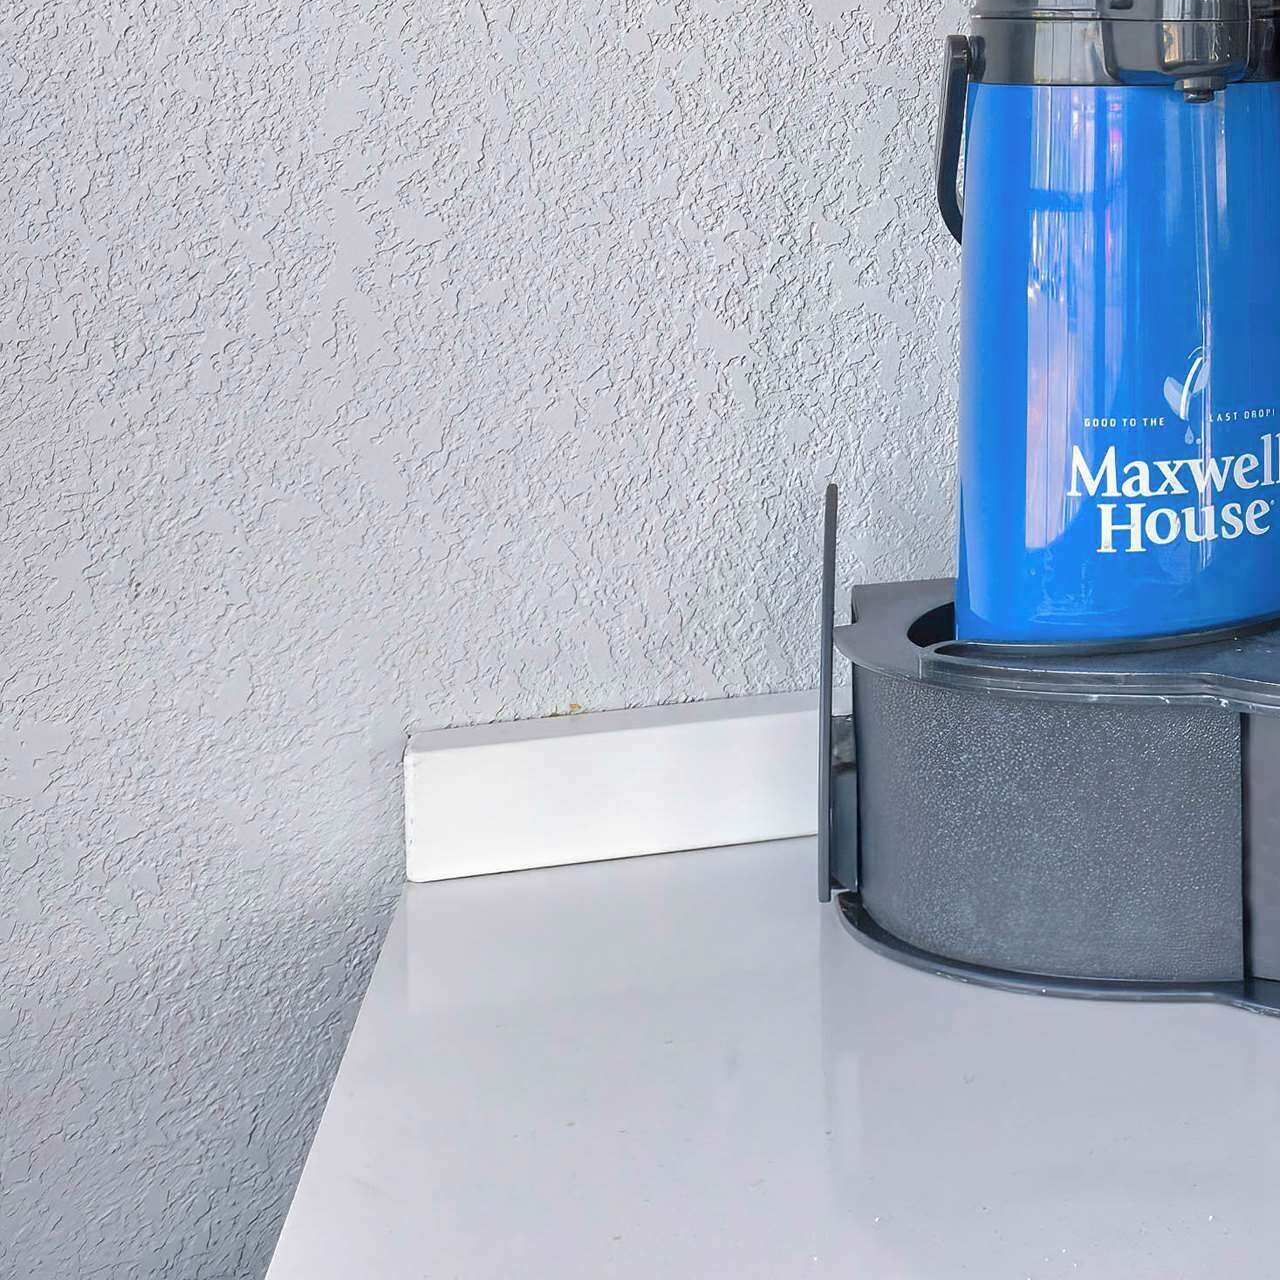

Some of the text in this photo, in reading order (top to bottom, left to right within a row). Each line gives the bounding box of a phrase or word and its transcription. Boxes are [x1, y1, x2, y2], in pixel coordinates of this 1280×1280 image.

[1084, 418, 1115, 427] GOOD
[1123, 418, 1135, 426] TO
[1143, 417, 1164, 426] THE
[1244, 408, 1274, 419] DROP!
[1096, 498, 1271, 551] House
